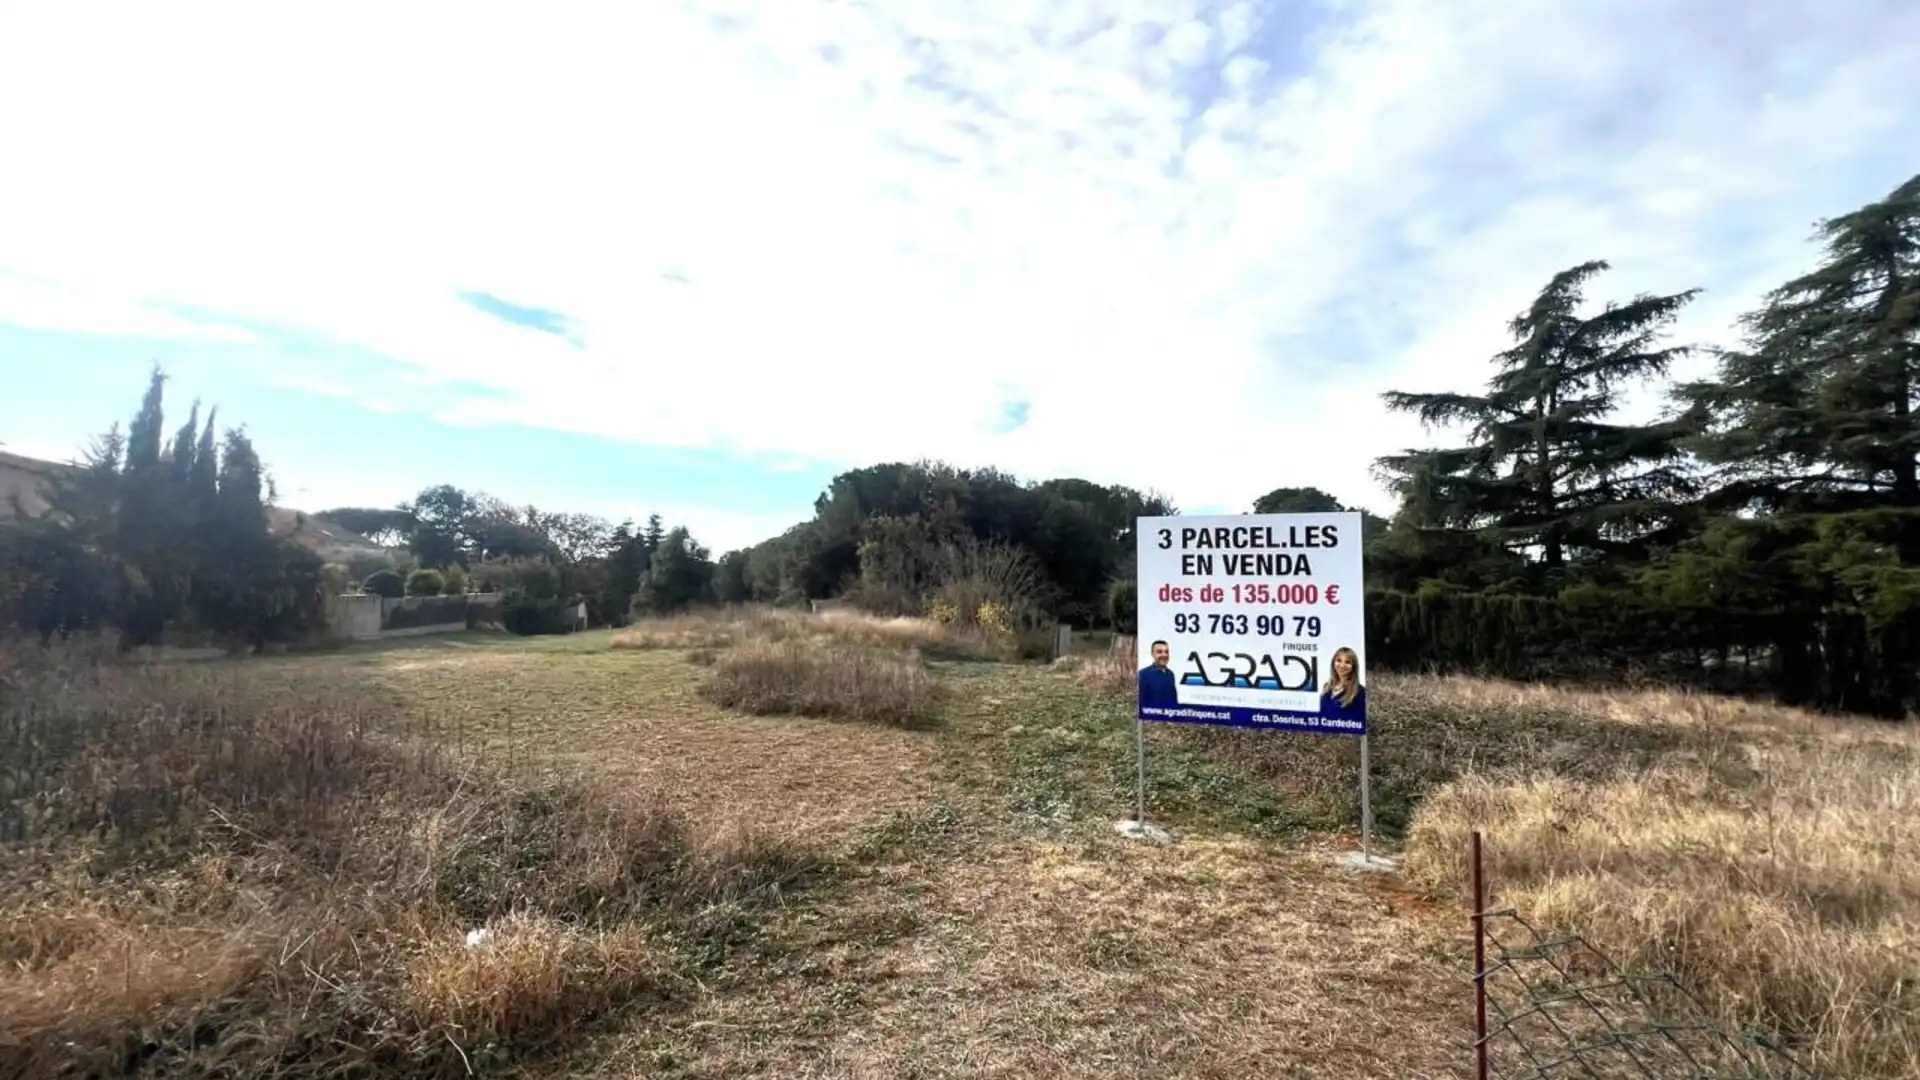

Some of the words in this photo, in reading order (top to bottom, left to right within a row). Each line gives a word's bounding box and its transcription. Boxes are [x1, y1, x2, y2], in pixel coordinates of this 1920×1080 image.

[1158, 528, 1172, 549] 3
[1181, 525, 1338, 549] PARCEL.LES
[1181, 554, 1213, 576] EN
[1222, 554, 1312, 576] VENDA
[1158, 584, 1193, 603] des
[1200, 584, 1224, 603] de
[1231, 584, 1318, 604] 135.000
[1325, 585, 1340, 605] €
[1174, 613, 1200, 634] 93
[1207, 614, 1249, 635] 763
[1256, 615, 1285, 636] 90
[1292, 616, 1321, 637] 79
[1282, 642, 1318, 651] FINQUES
[1179, 651, 1318, 692] AGRADI
